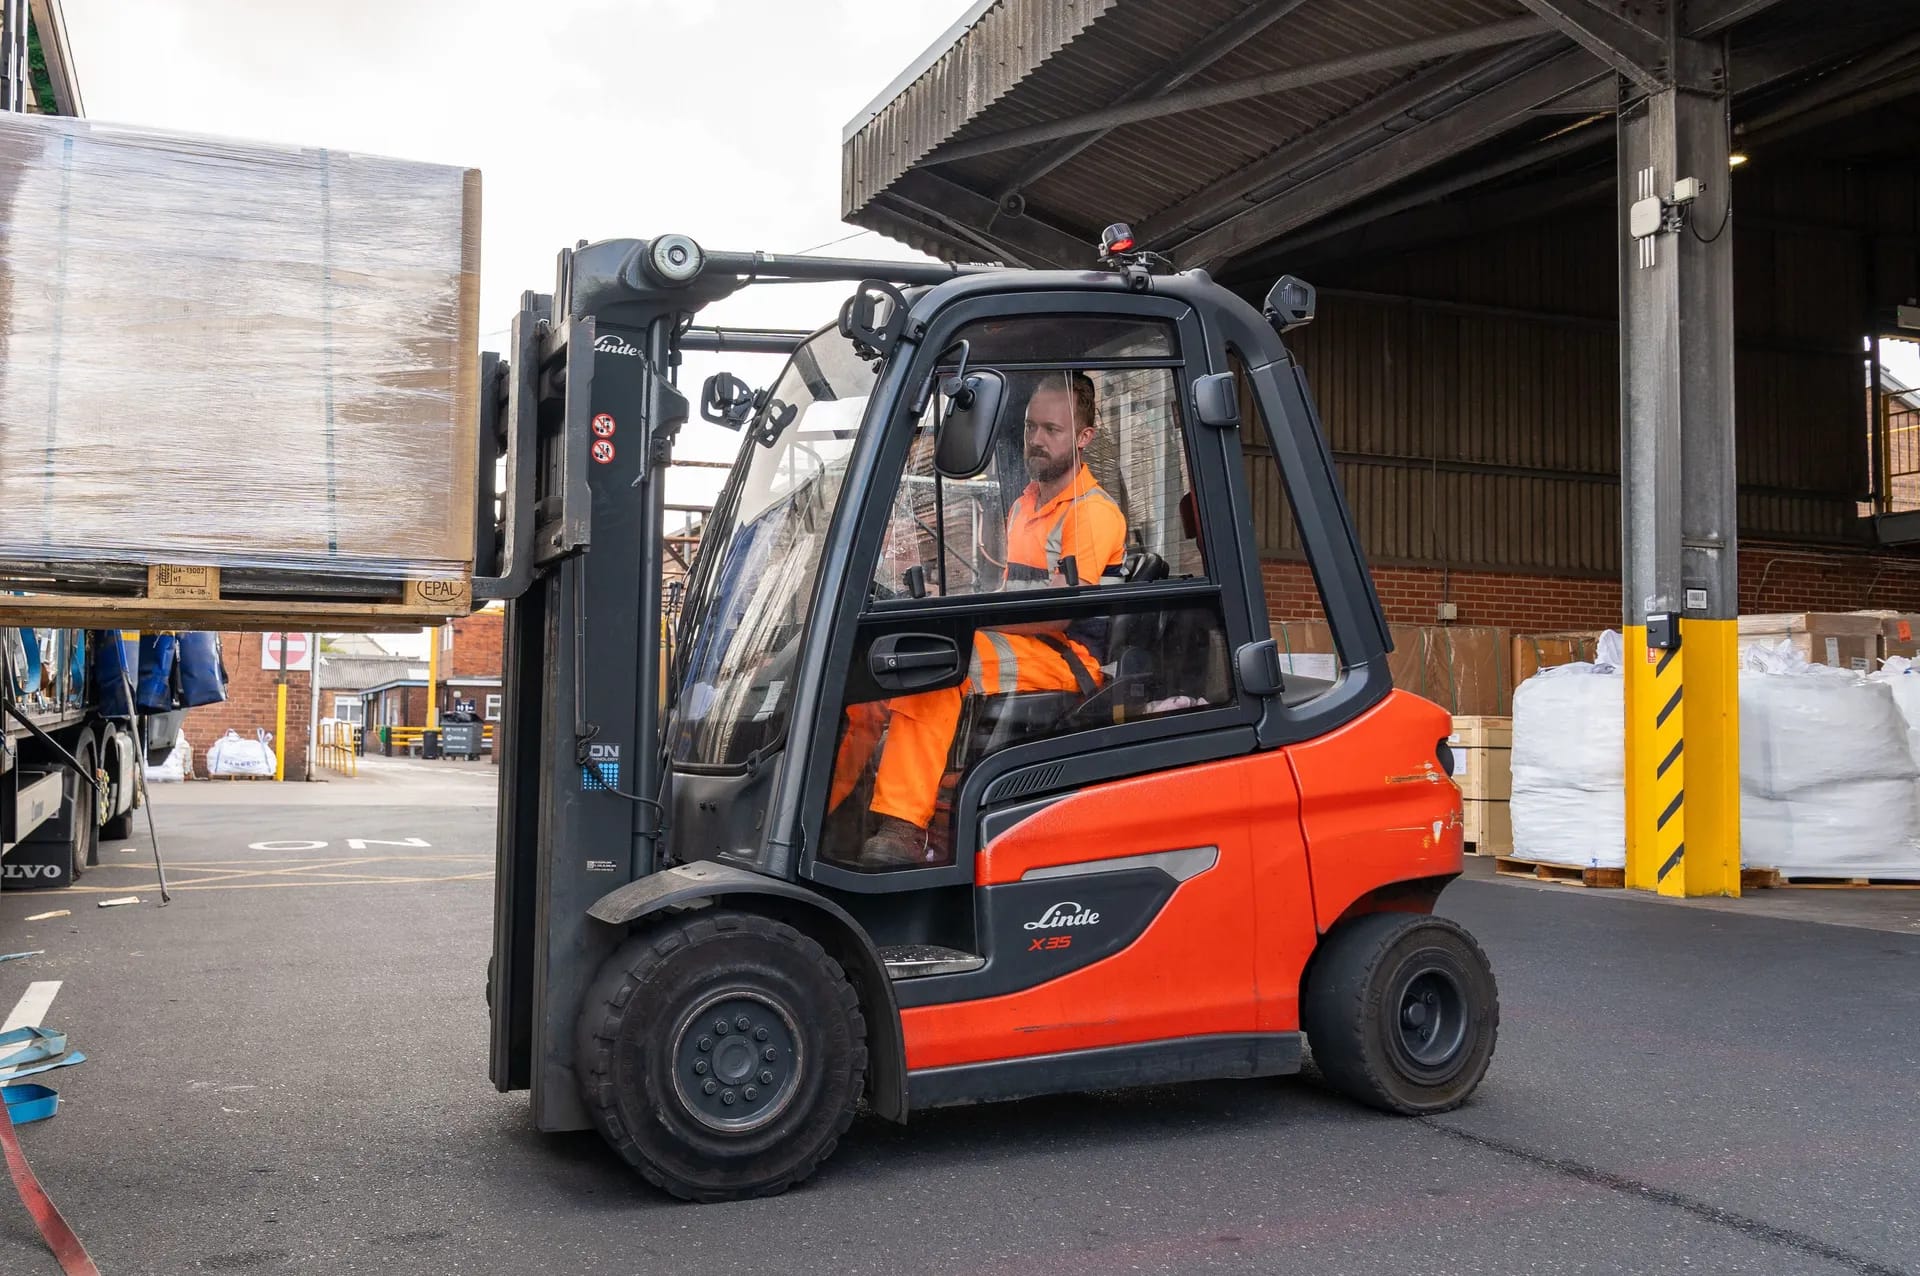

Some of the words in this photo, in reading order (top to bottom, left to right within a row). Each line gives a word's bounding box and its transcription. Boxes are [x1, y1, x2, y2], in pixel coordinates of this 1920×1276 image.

[424, 580, 458, 596] EPAL
[0, 864, 62, 878] LVO
[1023, 901, 1100, 930] Linde
